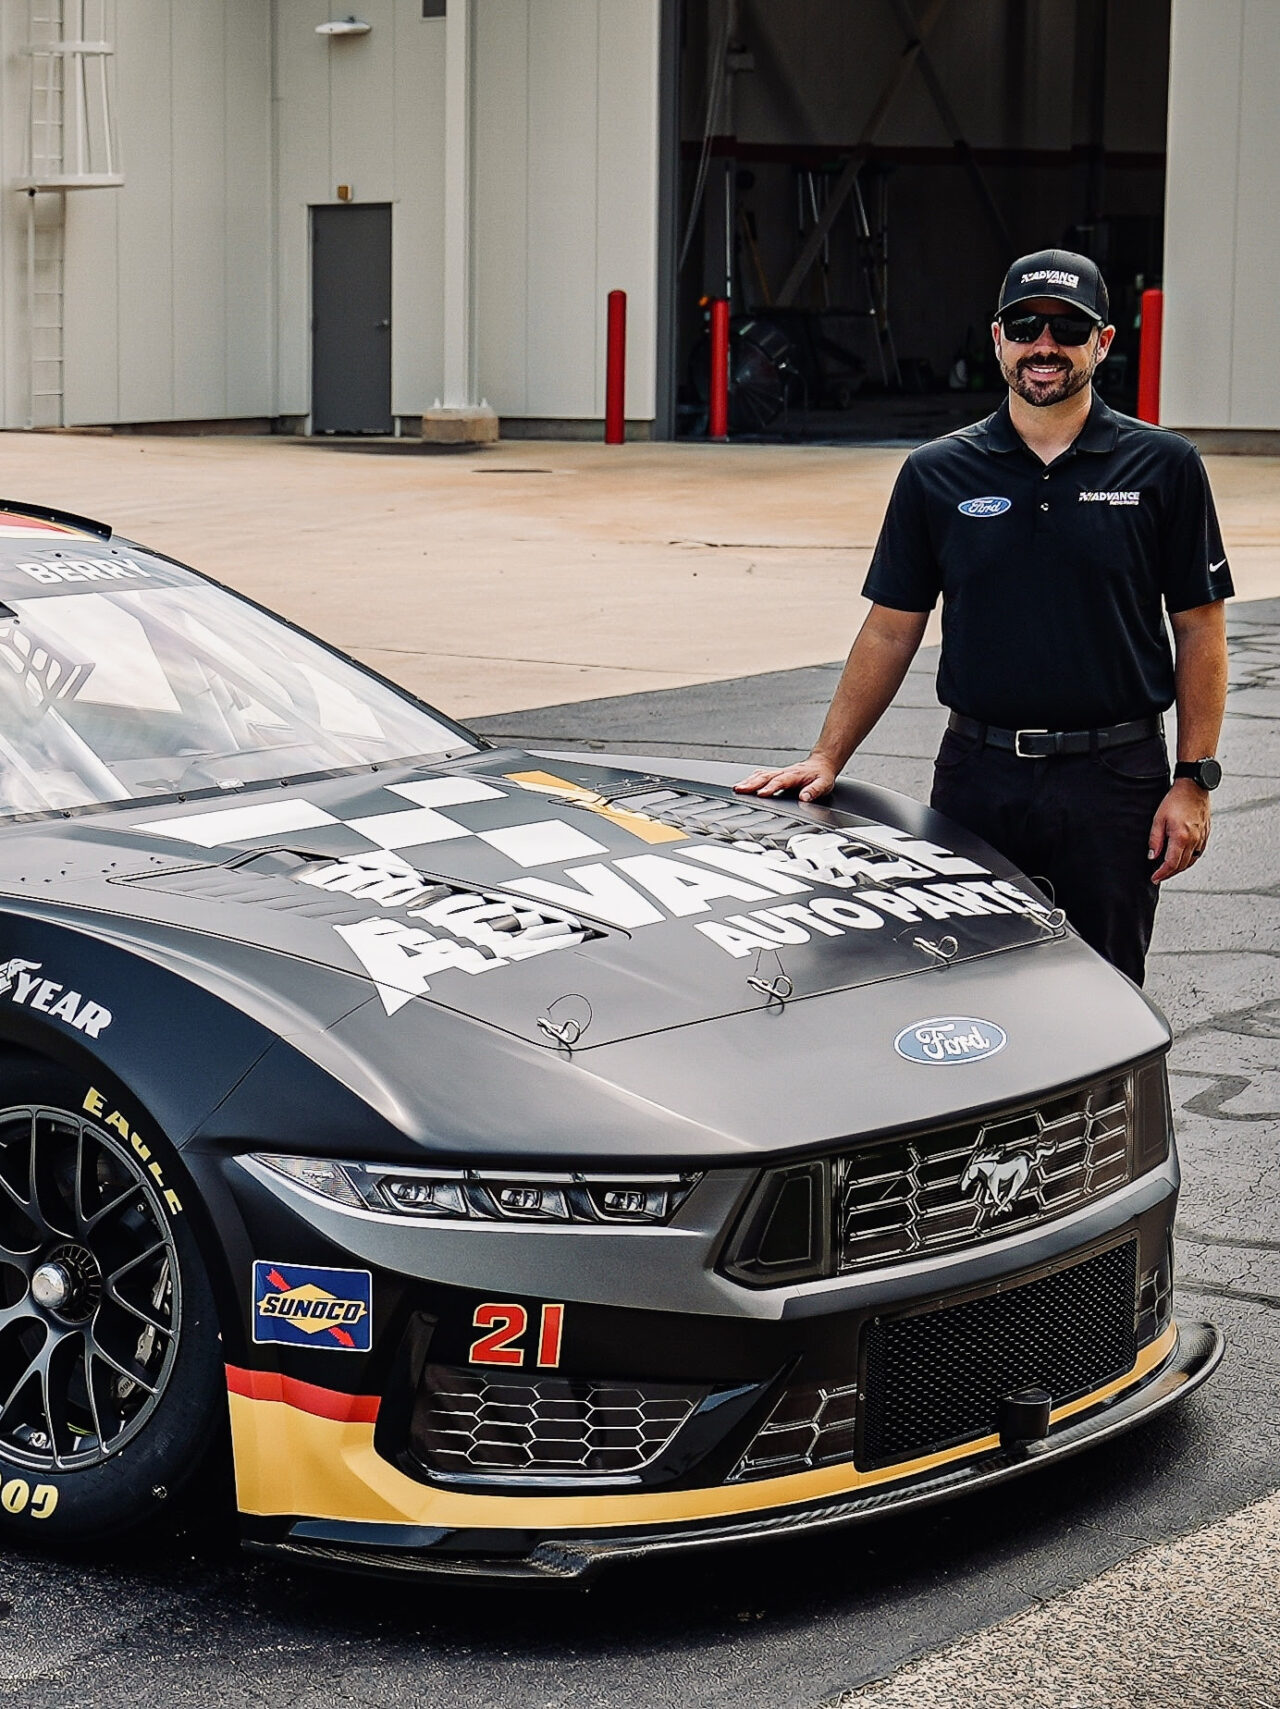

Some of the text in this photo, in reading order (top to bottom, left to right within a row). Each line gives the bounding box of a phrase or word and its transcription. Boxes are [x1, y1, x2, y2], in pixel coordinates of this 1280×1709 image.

[1031, 269, 1079, 284] ADVANCE
[967, 498, 1003, 514] Ford
[1090, 491, 1141, 502] ADVANCE
[16, 559, 152, 585] BERRY
[694, 879, 1051, 958] AUTO PARTS
[913, 1022, 991, 1060] Ford
[82, 1086, 183, 1217] EAGLE
[263, 1296, 361, 1322] SUNOCO
[469, 1302, 565, 1368] 21
